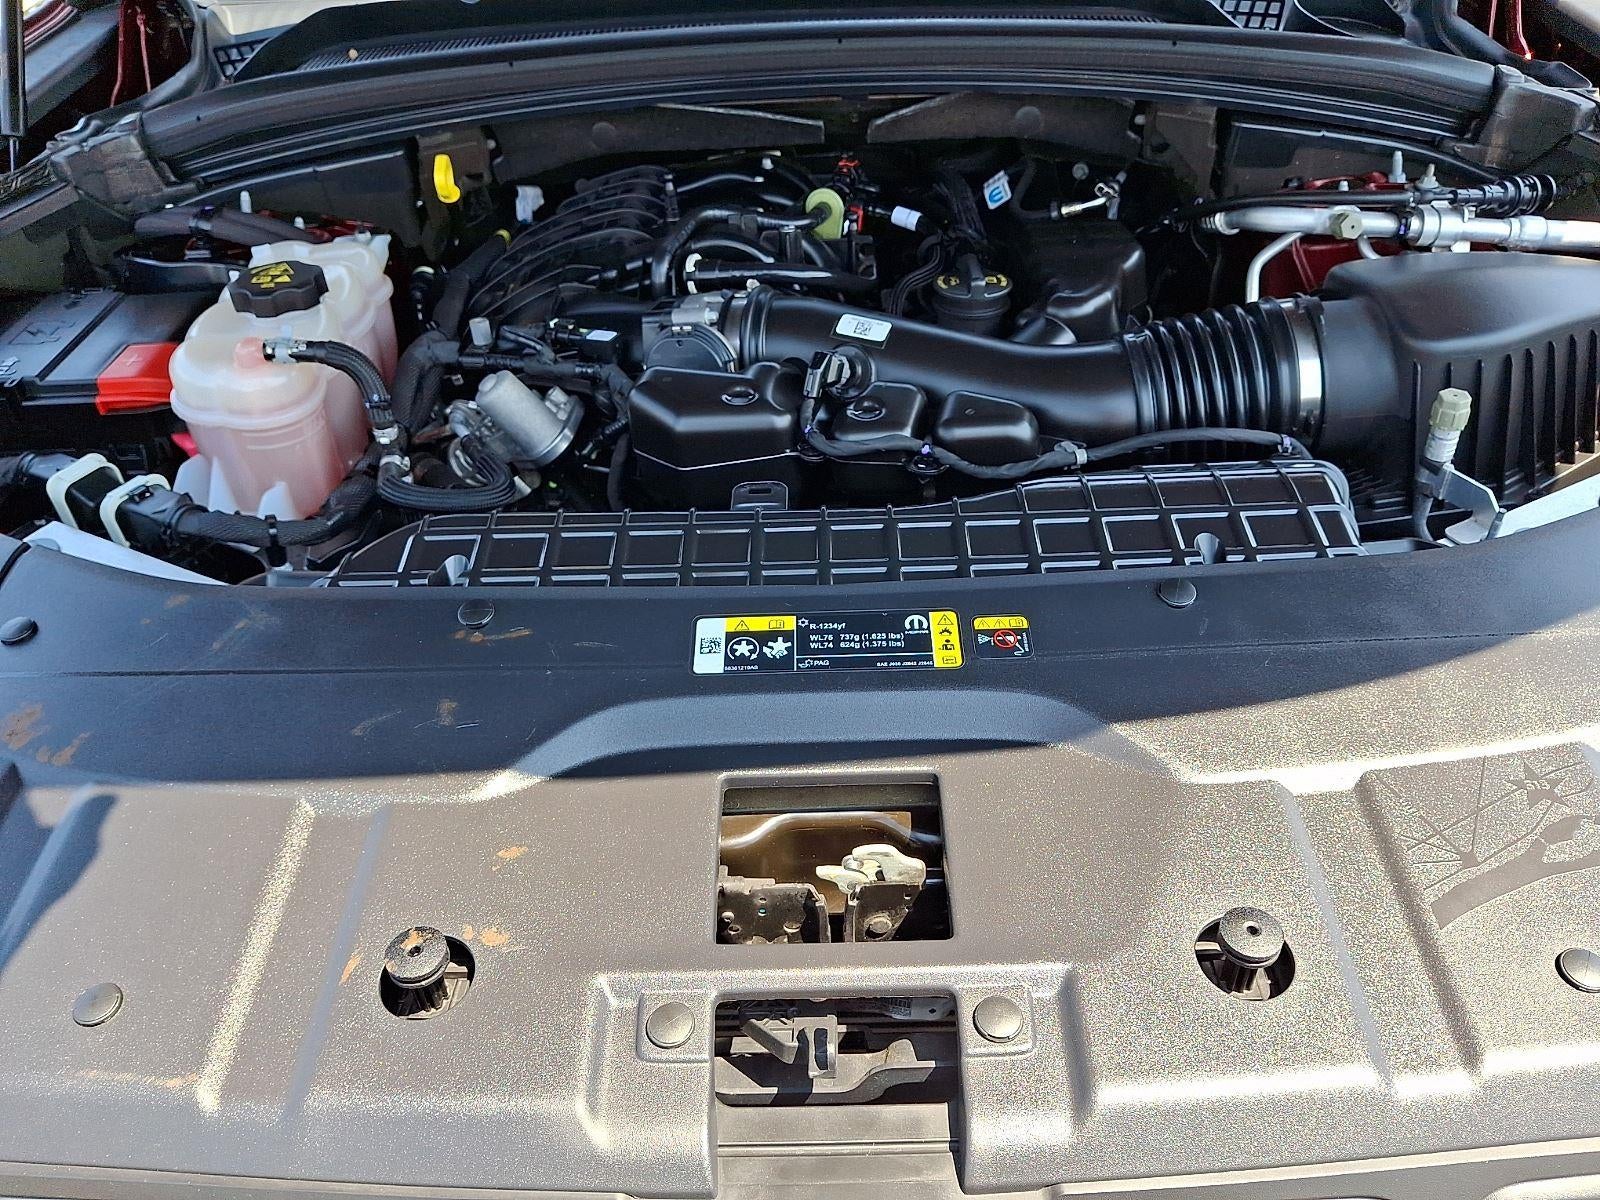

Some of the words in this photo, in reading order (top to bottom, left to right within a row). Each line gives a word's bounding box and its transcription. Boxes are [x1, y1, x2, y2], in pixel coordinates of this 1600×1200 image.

[810, 622, 846, 630] R-1234yf
[839, 633, 860, 641] 737g
[888, 632, 905, 641] lbs)
